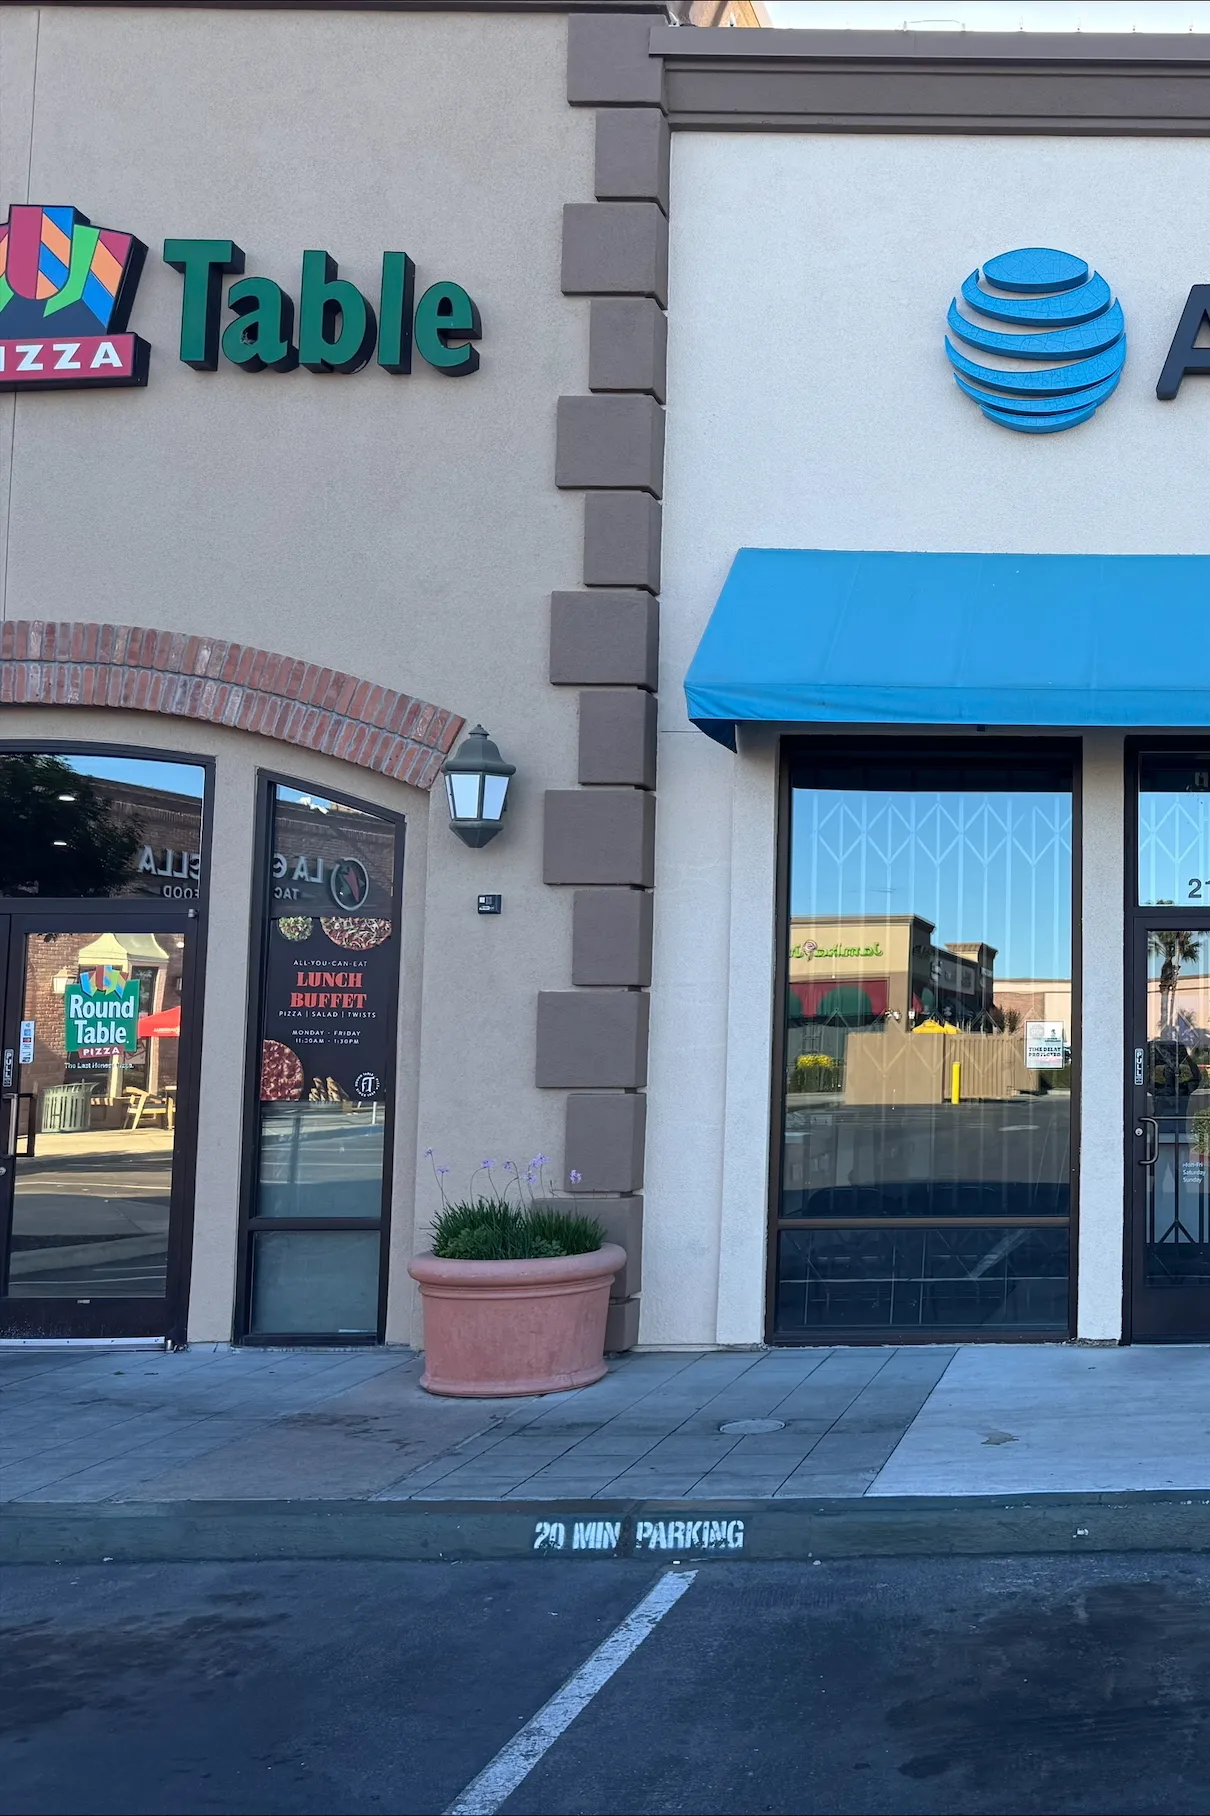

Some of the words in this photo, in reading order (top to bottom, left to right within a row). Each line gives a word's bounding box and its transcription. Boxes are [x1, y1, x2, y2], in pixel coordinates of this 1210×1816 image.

[163, 238, 482, 376] Table
[296, 971, 363, 988] LUNCH
[69, 994, 134, 1019] Round
[290, 992, 368, 1009] BUFFET
[83, 1046, 120, 1056] PIZZA
[5, 1052, 13, 1078] PULL
[534, 1522, 566, 1549] 20
[572, 1521, 622, 1550] MIN
[636, 1520, 745, 1549] PARKING
